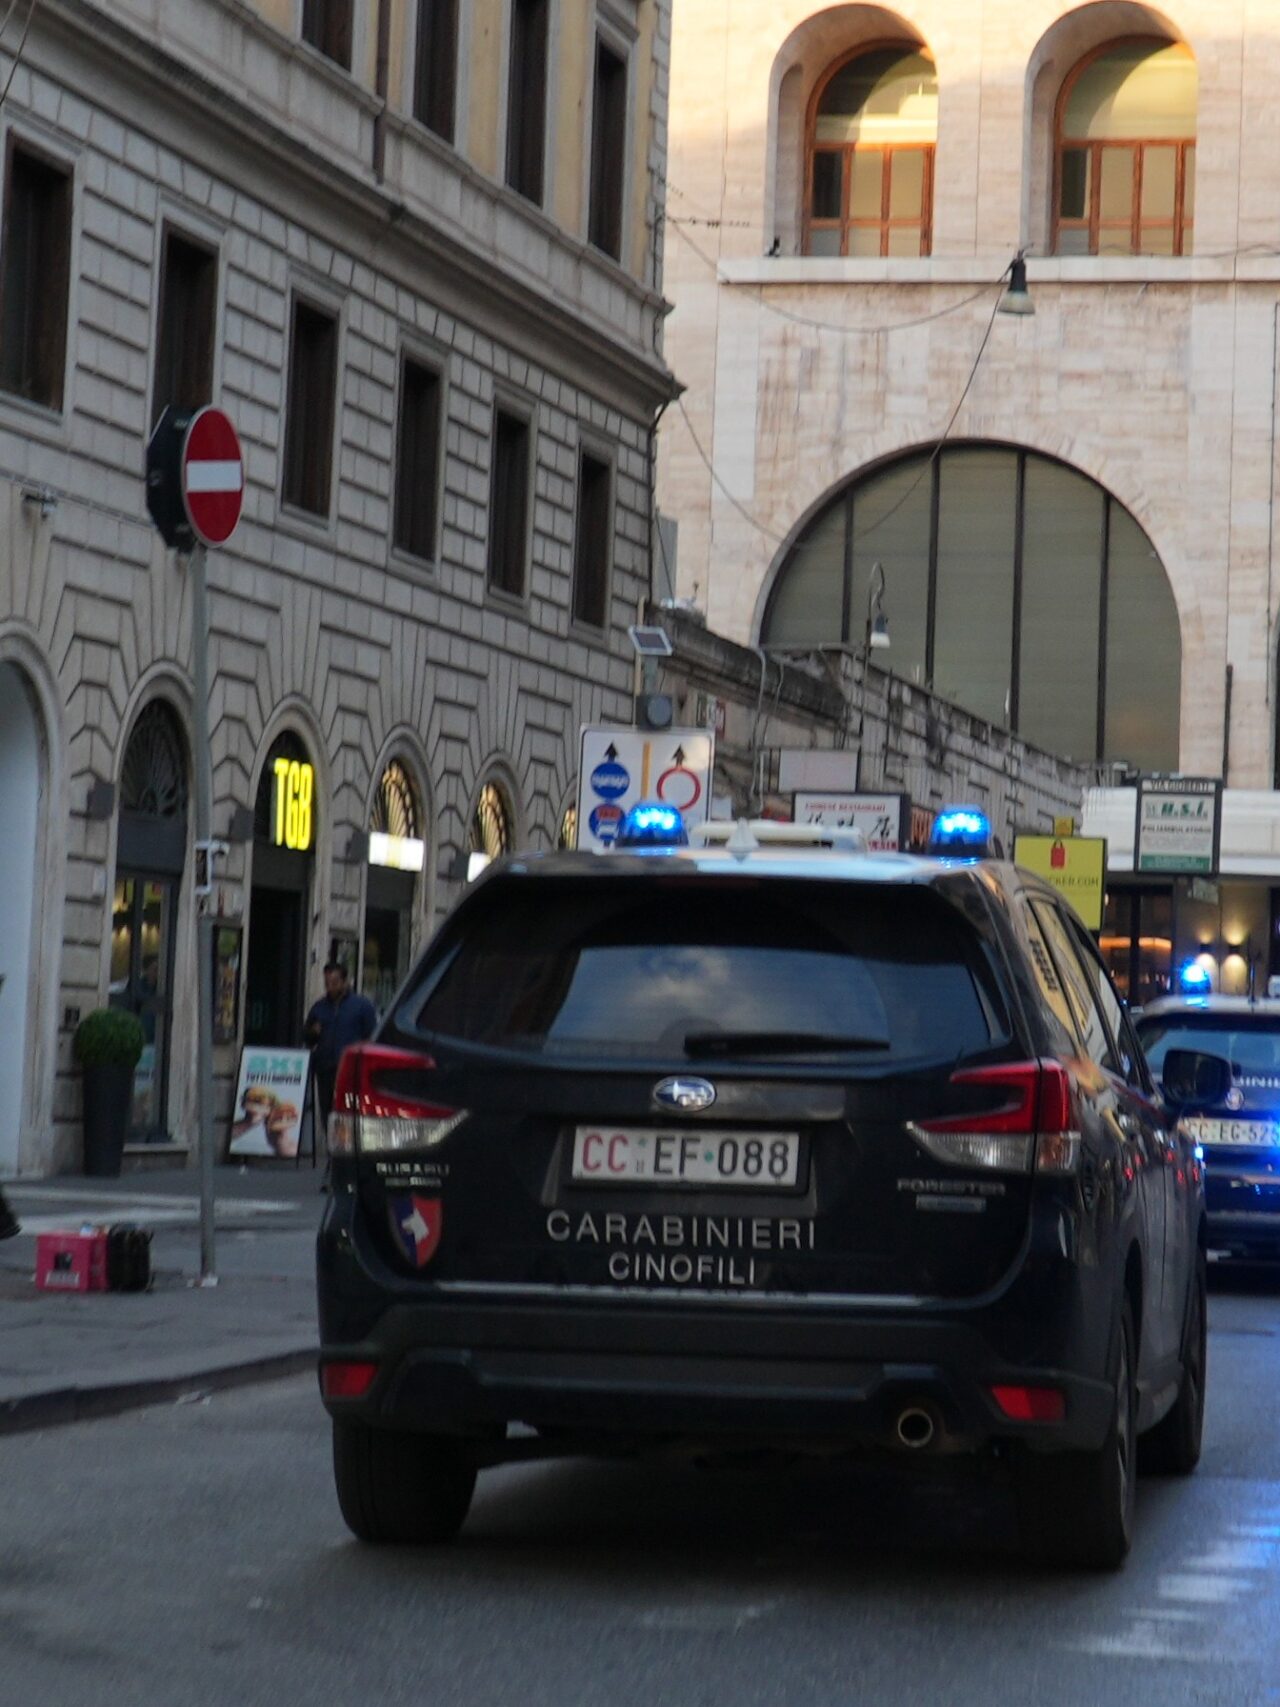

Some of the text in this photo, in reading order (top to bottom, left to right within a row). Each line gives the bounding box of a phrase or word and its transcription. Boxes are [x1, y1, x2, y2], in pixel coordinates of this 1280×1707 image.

[274, 758, 313, 850] TGB
[546, 1209, 815, 1250] CARABINIERI
[609, 1252, 755, 1285] CINOFILI
